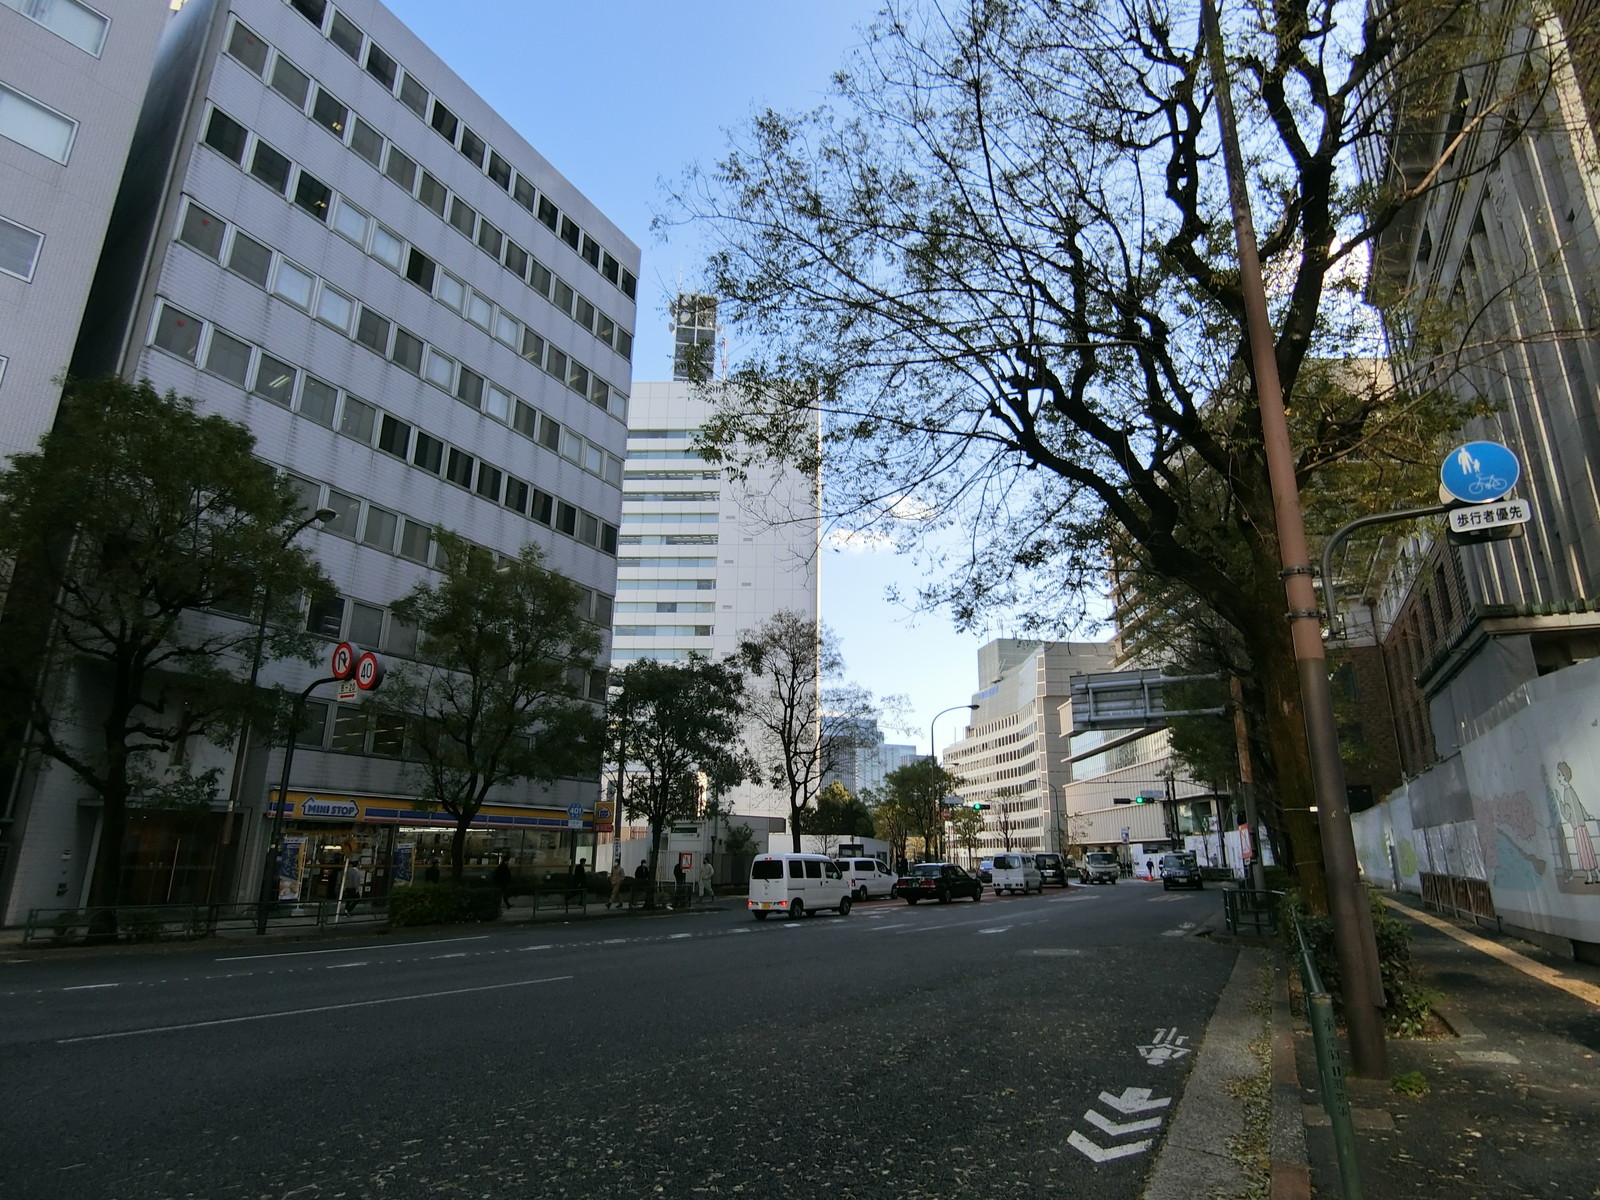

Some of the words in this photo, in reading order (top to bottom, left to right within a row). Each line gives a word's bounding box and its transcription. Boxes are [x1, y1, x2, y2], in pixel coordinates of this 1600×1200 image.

[1457, 505, 1523, 528] 歩行者優先
[360, 663, 373, 680] 40
[307, 804, 330, 814] MINI
[331, 805, 355, 815] STOP
[569, 807, 582, 815] 401
